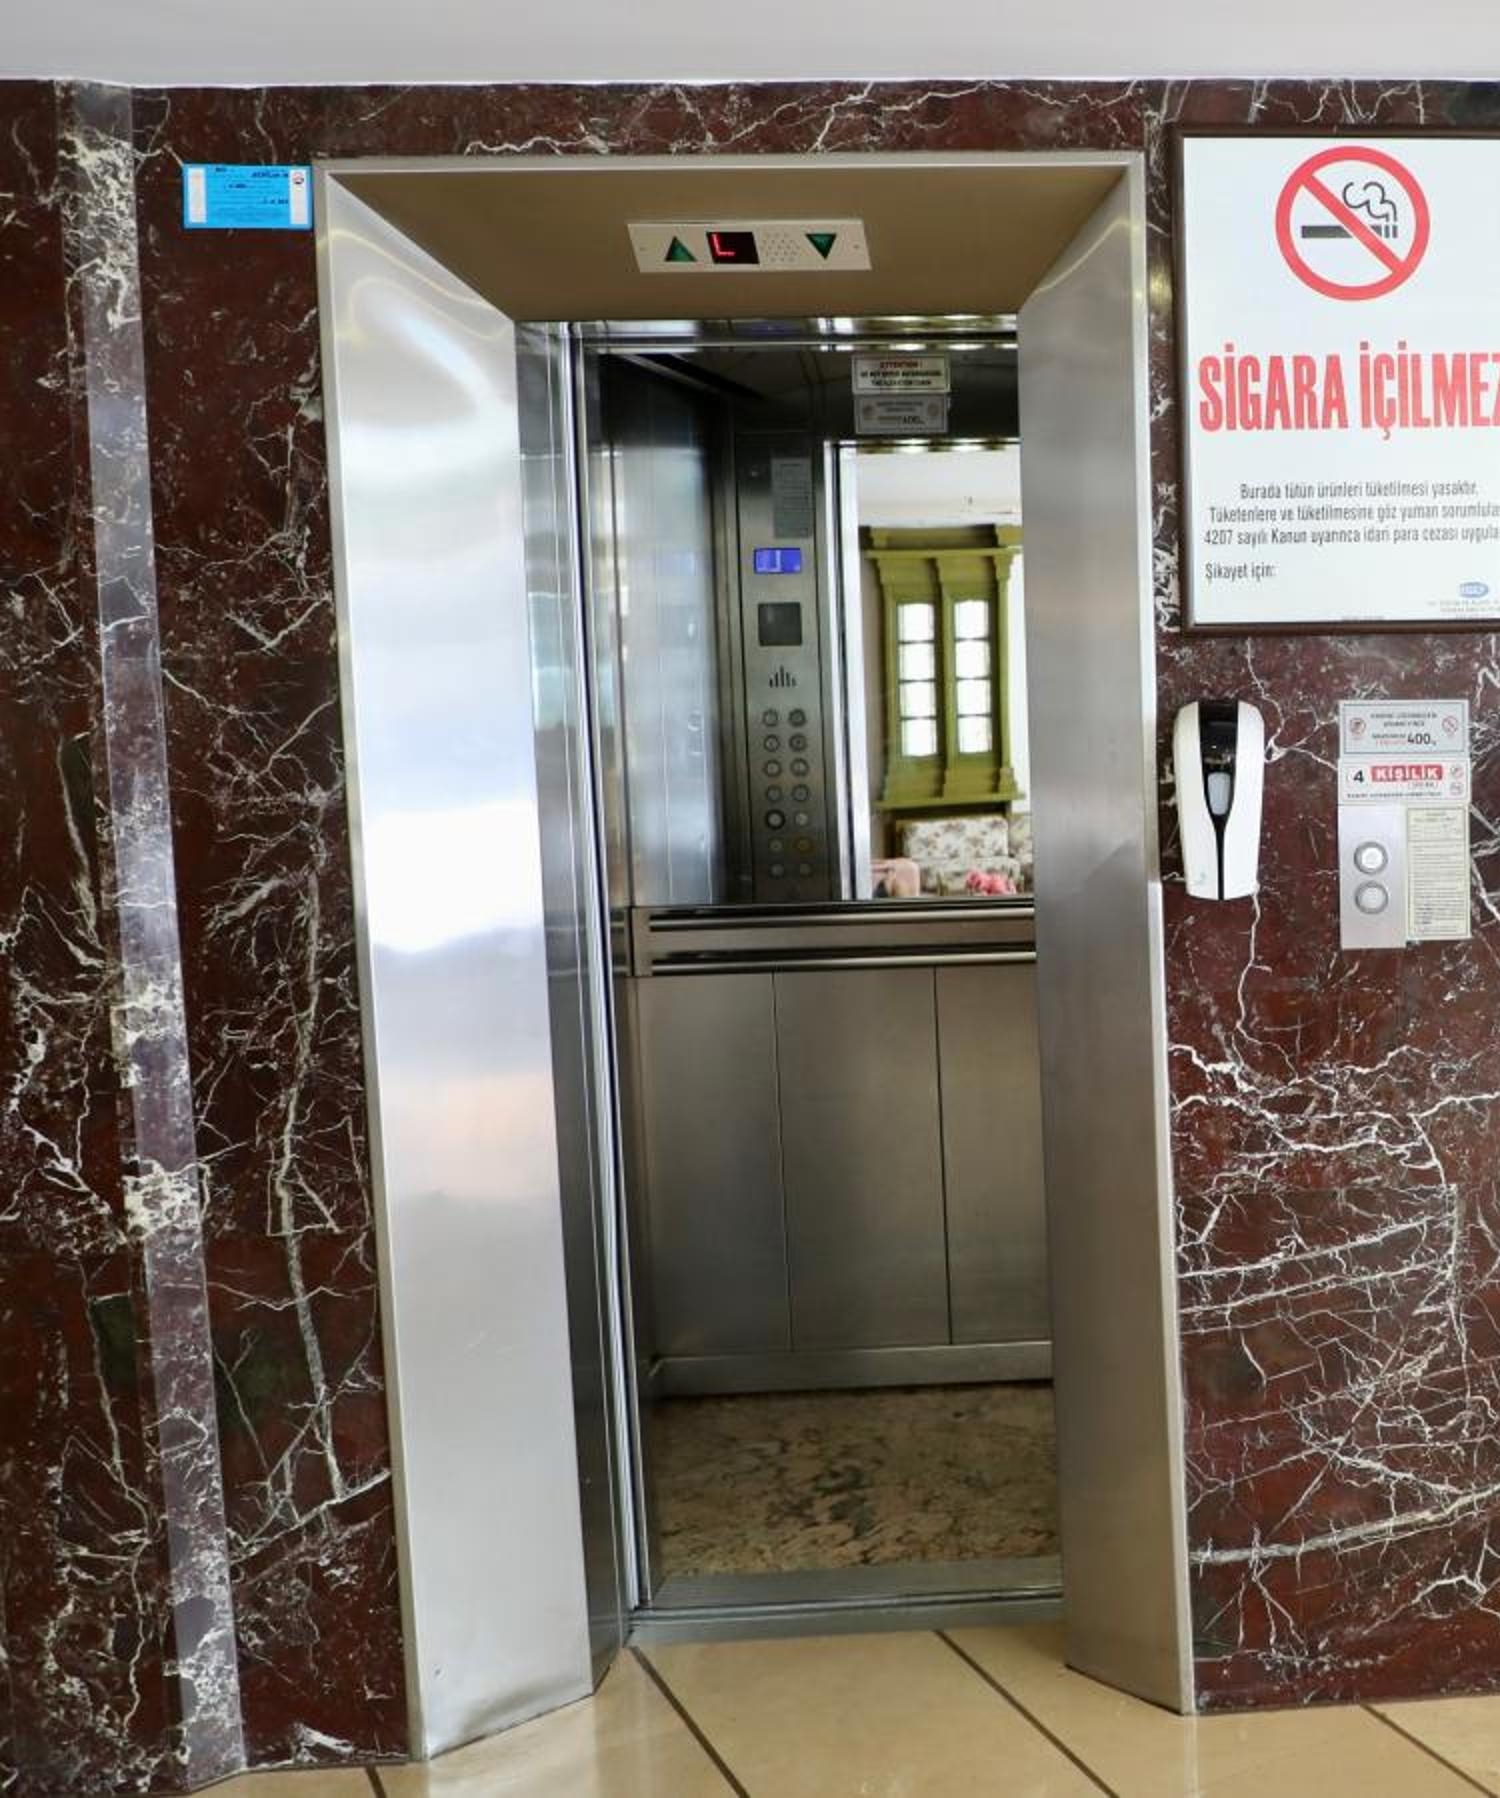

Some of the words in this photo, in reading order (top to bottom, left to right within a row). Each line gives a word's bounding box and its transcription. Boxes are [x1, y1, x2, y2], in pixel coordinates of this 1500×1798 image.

[711, 233, 737, 257] L
[1198, 343, 1349, 432] SİGARA
[1240, 483, 1282, 499] Burada
[1285, 481, 1315, 498] tütün
[1317, 480, 1362, 498] ürünleri
[1365, 480, 1430, 497] tüketilmesi
[1431, 479, 1479, 499] yasaktır.
[1209, 505, 1278, 523] Tüketenlere
[1281, 508, 1294, 521] ve
[1297, 503, 1374, 521] tüketilmesine
[1377, 503, 1397, 523] göz
[1400, 505, 1439, 522] yuman
[1204, 529, 1233, 545] 4207
[1237, 528, 1269, 548] sayılı
[1271, 528, 1307, 544] Kanun
[1311, 529, 1361, 547] uyarınca
[1363, 525, 1390, 542] idari
[1393, 528, 1420, 544] para
[1422, 526, 1459, 542] cezası
[1205, 563, 1248, 586] Şikayet
[1251, 562, 1277, 582] için:
[1407, 733, 1431, 745] 400
[1353, 769, 1365, 783] 4
[1375, 766, 1440, 780] KİŞİLİK
